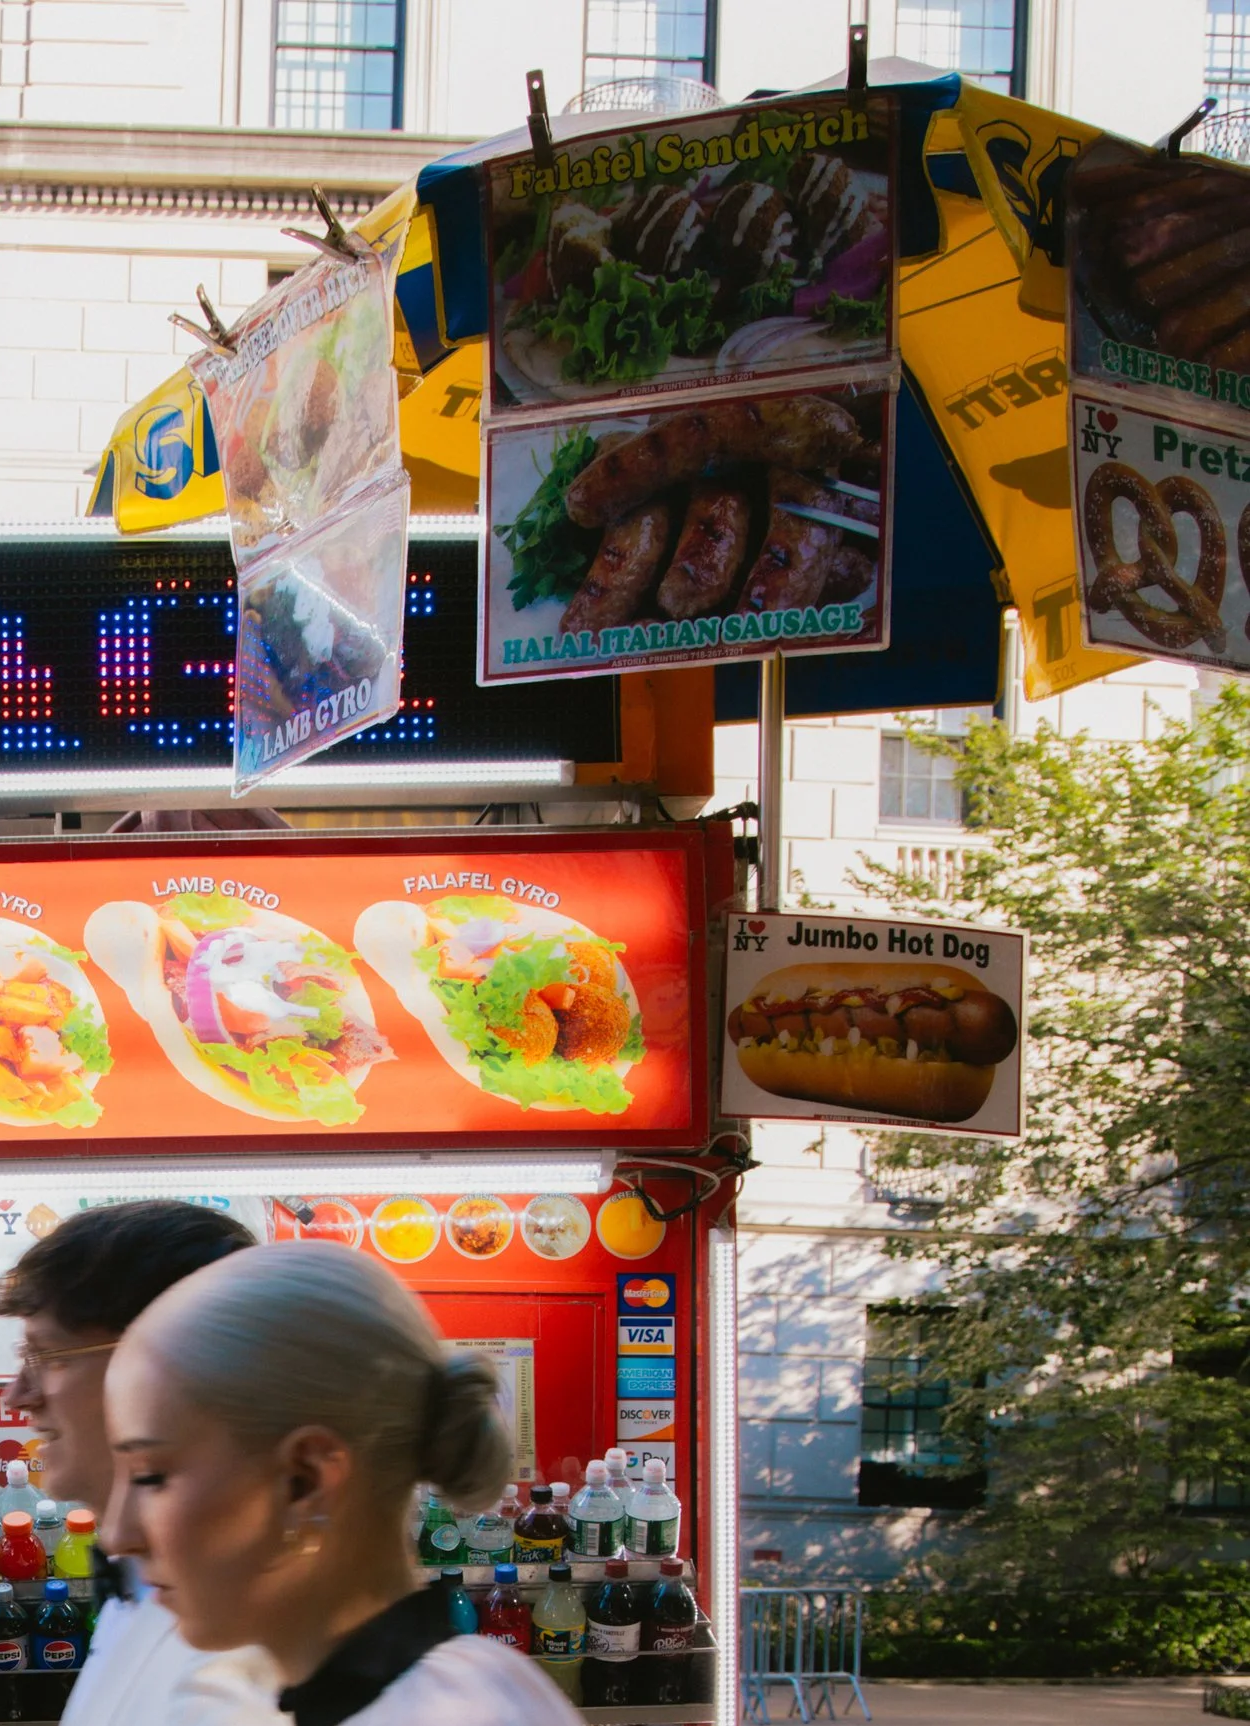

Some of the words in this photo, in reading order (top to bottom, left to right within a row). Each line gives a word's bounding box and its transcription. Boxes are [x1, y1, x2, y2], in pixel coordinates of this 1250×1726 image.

[509, 143, 646, 199] Falafel
[657, 108, 869, 174] Sandwich
[278, 287, 324, 344] OVER
[325, 259, 370, 312] RICE
[1101, 339, 1211, 397] CHEESE
[620, 386, 655, 397] ASTORIA
[657, 381, 697, 392] PRINTING
[1085, 405, 1096, 430] I
[1081, 429, 1122, 459] NY
[502, 630, 594, 665] HALAL
[599, 617, 721, 656] ITALIAN
[722, 602, 864, 643] SAUSAGE
[611, 657, 647, 668] ASTORIA
[649, 653, 689, 664] PRINTING
[262, 709, 310, 763] LAMB
[315, 678, 372, 732] GYRO
[152, 875, 215, 897] LAMB
[220, 881, 280, 911] GYRO
[402, 872, 496, 895] FALAFEL
[500, 878, 561, 910] GYRO
[738, 919, 747, 935] I
[733, 935, 769, 952] NY
[787, 921, 878, 950] Jumbo
[888, 928, 934, 956] Hot
[943, 934, 990, 968] Dog
[627, 1328, 665, 1343] VISA
[618, 1368, 673, 1379] AMERICAN
[629, 1380, 676, 1391] EXPRESS
[620, 1409, 671, 1420] DISCOVER
[45, 1651, 74, 1661] PEPSI
